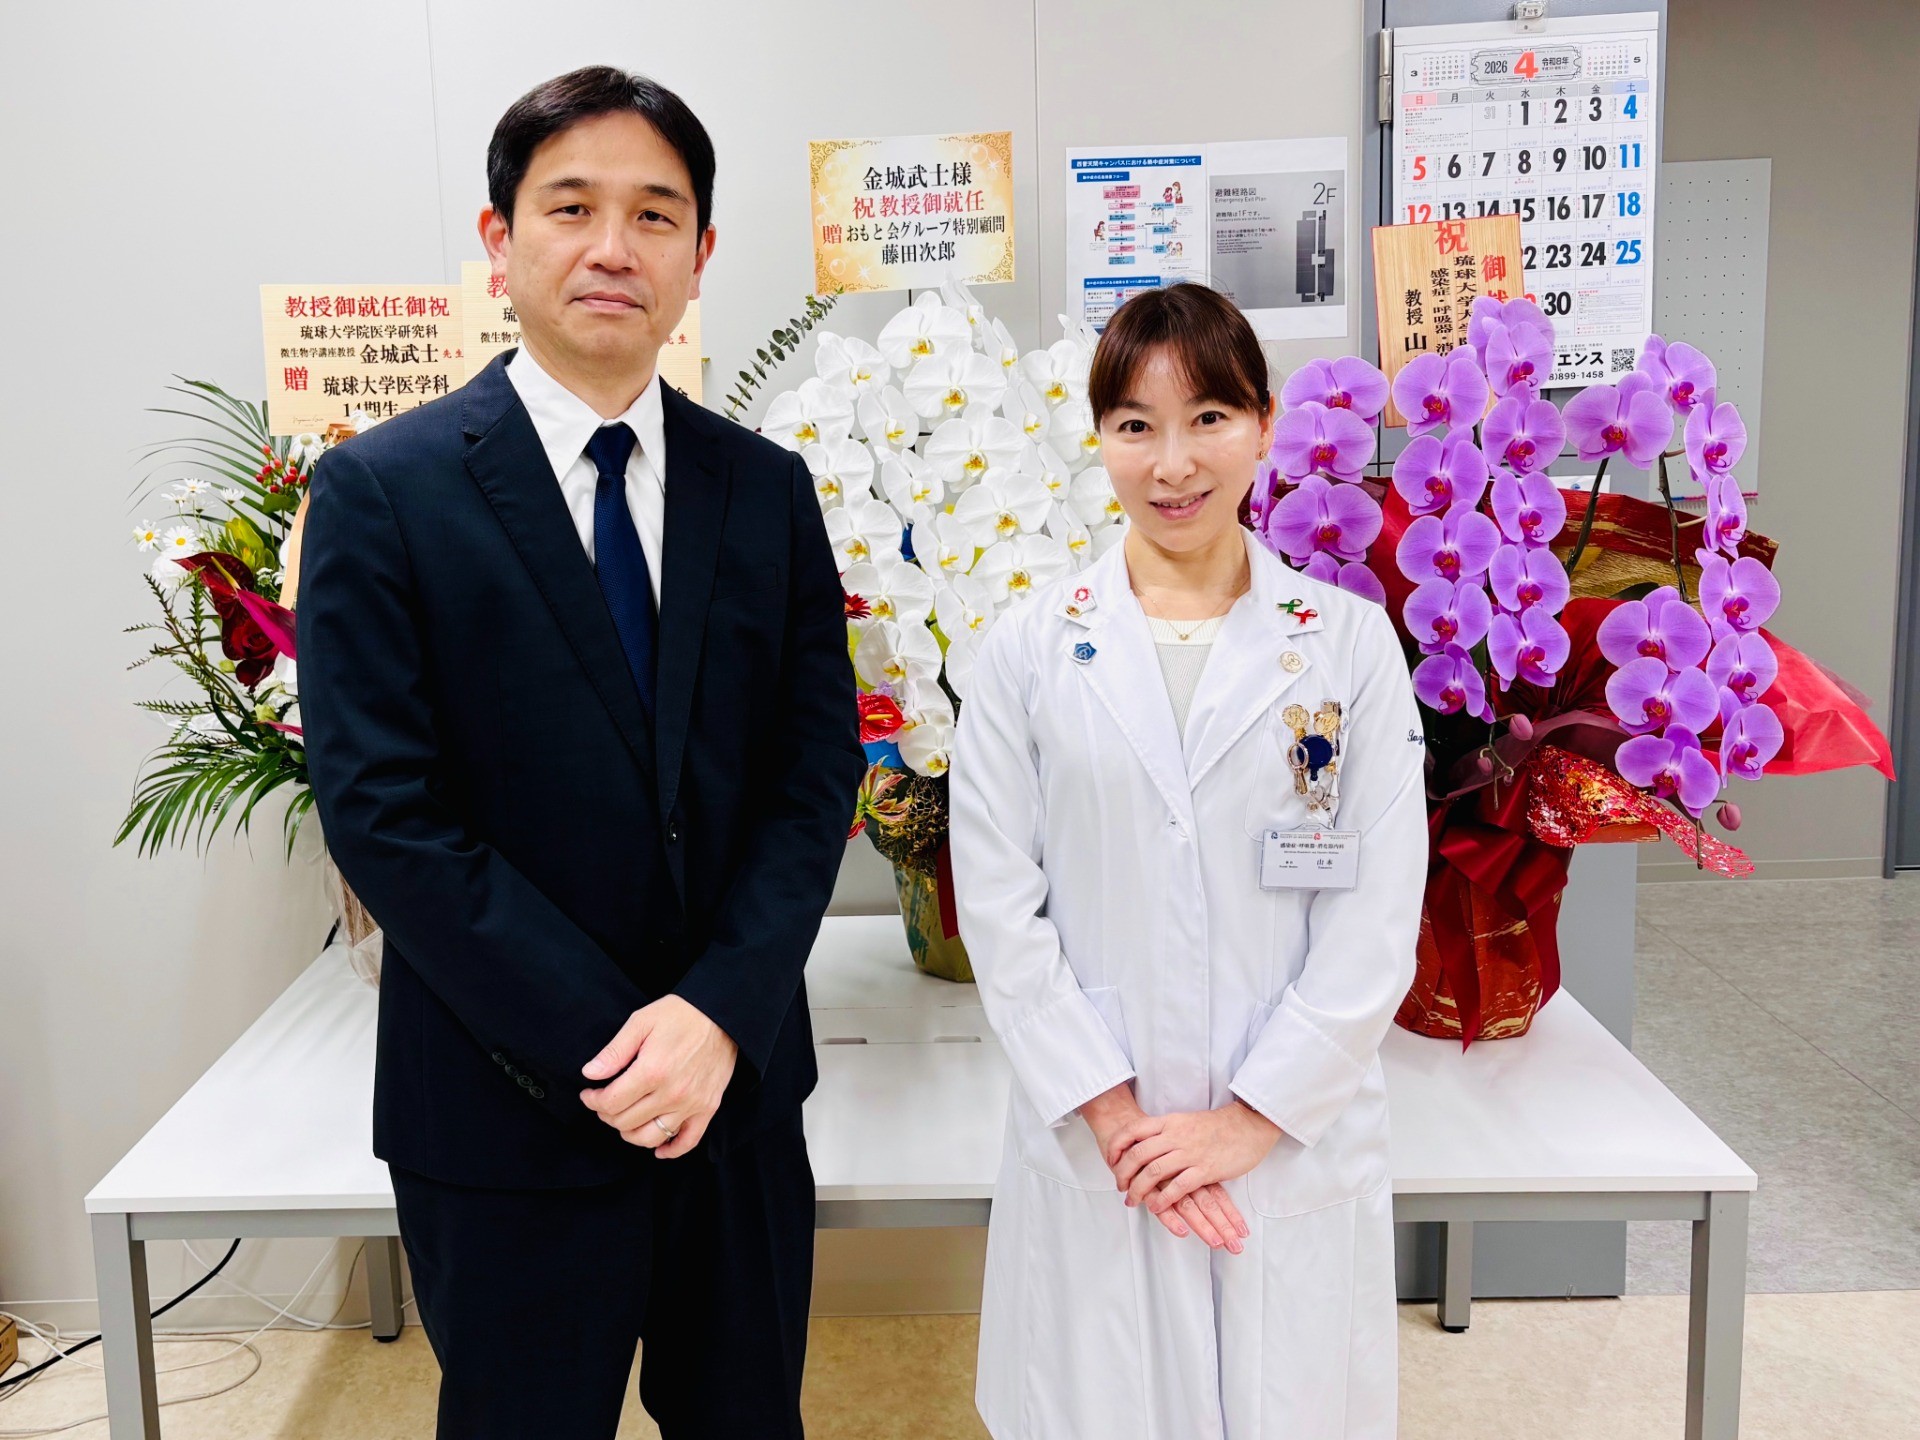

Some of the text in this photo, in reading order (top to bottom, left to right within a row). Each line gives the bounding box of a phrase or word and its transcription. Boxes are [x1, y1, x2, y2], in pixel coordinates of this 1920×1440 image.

[1484, 61, 1508, 75] 2026
[1514, 51, 1539, 79] 4
[1541, 56, 1570, 67] 令和8年
[1415, 82, 1636, 104] 日 月 火 水 木 金 土
[1484, 94, 1638, 126] 31 1 2 3 4
[1412, 143, 1641, 181] 5 6 7 8 9 10 11
[862, 162, 973, 191] 金城武士様
[852, 189, 985, 220] 祝 教授御就任
[1214, 187, 1257, 198] 避難経路図
[1313, 182, 1337, 205] 2F
[1407, 203, 1432, 225] 12
[1442, 201, 1466, 221] 13
[1512, 197, 1536, 223] 15
[1547, 195, 1571, 221] 16
[1582, 193, 1606, 219] 17
[1617, 191, 1641, 217] 18
[822, 215, 1006, 245] 贈 おもと会グループ特別顧問
[1434, 221, 1469, 255] 祝
[881, 240, 956, 266] 藤田次郎
[1523, 239, 1642, 270] 2 23 24 25
[284, 294, 451, 319] 教授御就任御祝
[1430, 267, 1454, 357] 感染症・呼吸器・消
[1544, 291, 1572, 316] 30
[300, 323, 439, 340] 琉球大学院医学研究科
[1404, 289, 1427, 356] 教授 山
[280, 343, 464, 364] 微生物学講座教授 金城武士 先生
[1554, 351, 1604, 367] エンス
[283, 366, 450, 397] 贈 琉球大学医学科
